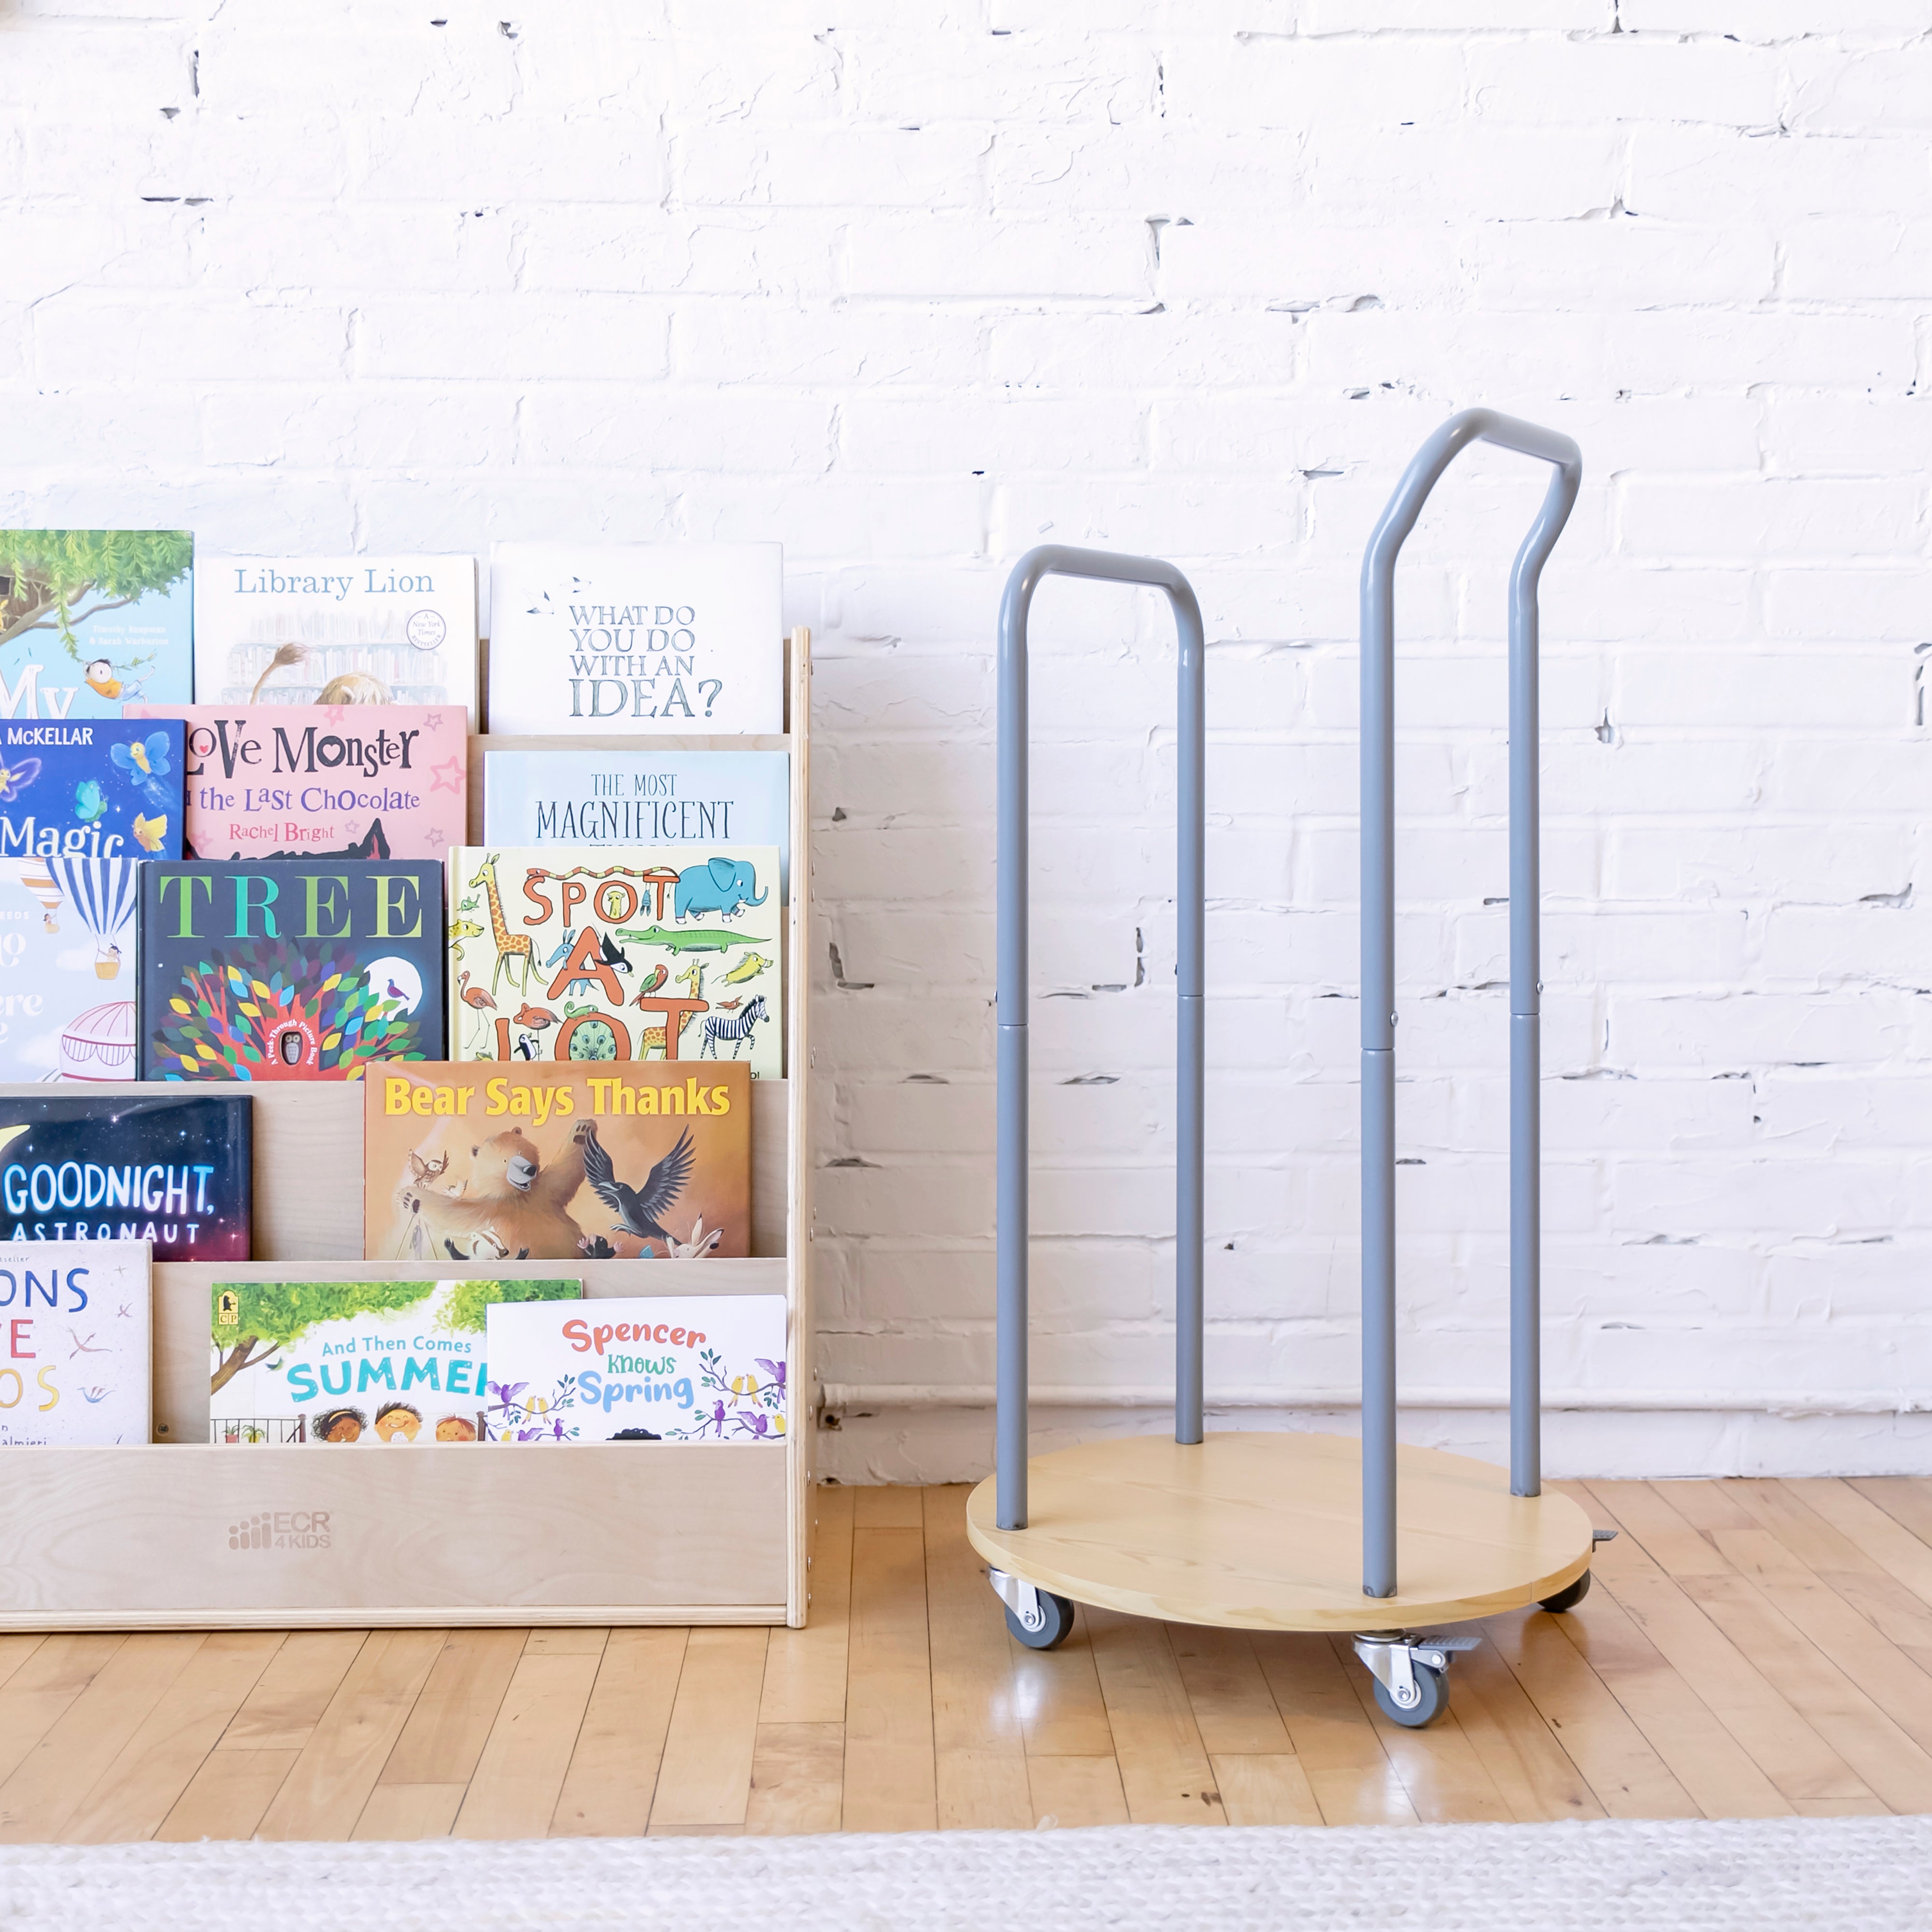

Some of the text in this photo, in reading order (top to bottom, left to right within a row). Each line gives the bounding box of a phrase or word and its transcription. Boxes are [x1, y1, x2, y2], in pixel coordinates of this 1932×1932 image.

[234, 568, 435, 601] Library Lion
[569, 605, 696, 625] WHAT DO
[569, 628, 696, 652] YOU DO
[569, 655, 695, 676] WITH AN
[568, 678, 723, 719] IDEA?
[7, 727, 93, 745] McKELLAR
[272, 726, 420, 778] Monster
[591, 774, 678, 796] THE MOST
[199, 786, 236, 811] the
[535, 800, 734, 840] MAGNIFICENT
[228, 823, 335, 842] Rachel Bright
[160, 875, 422, 938] TREE
[523, 875, 681, 927] SPOT
[547, 925, 625, 1006] A
[298, 1021, 315, 1045] Picture
[306, 1047, 317, 1065] Book
[385, 1077, 730, 1126] Bear Says Thanks
[4, 1161, 214, 1215] GOODNIGHT,
[12, 1222, 199, 1244] ASTRONAUT
[322, 1335, 472, 1356] And Then Comes
[562, 1319, 706, 1355] Spencer
[578, 1370, 695, 1413] Spring
[274, 1511, 331, 1533] ECR
[274, 1534, 331, 1549] 4 KIDS
